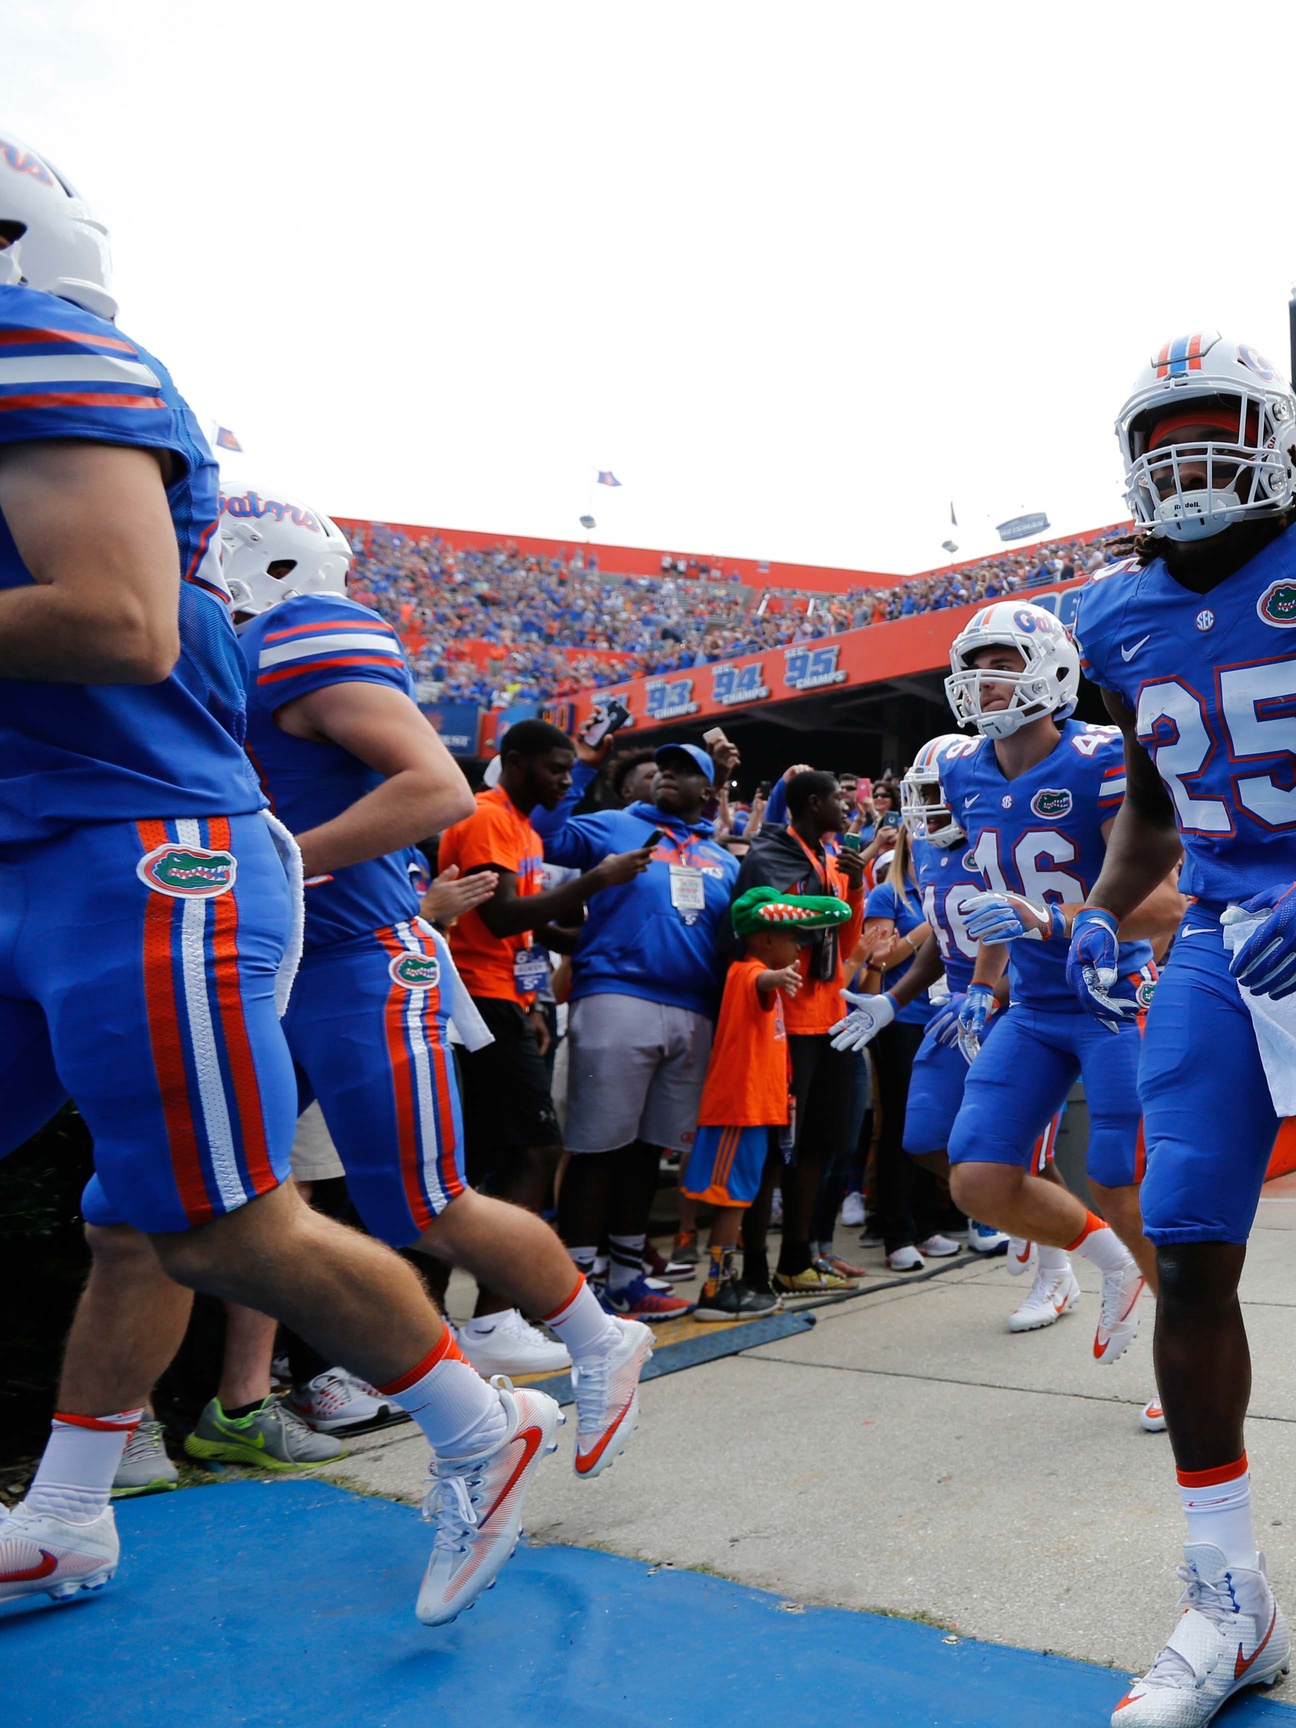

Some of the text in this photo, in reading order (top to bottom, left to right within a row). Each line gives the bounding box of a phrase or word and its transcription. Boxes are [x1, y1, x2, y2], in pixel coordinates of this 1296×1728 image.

[1195, 608, 1215, 632] SEC
[713, 663, 762, 701] 94
[785, 648, 839, 686] 95
[796, 670, 847, 689] CHAMPS
[646, 680, 692, 715] 93
